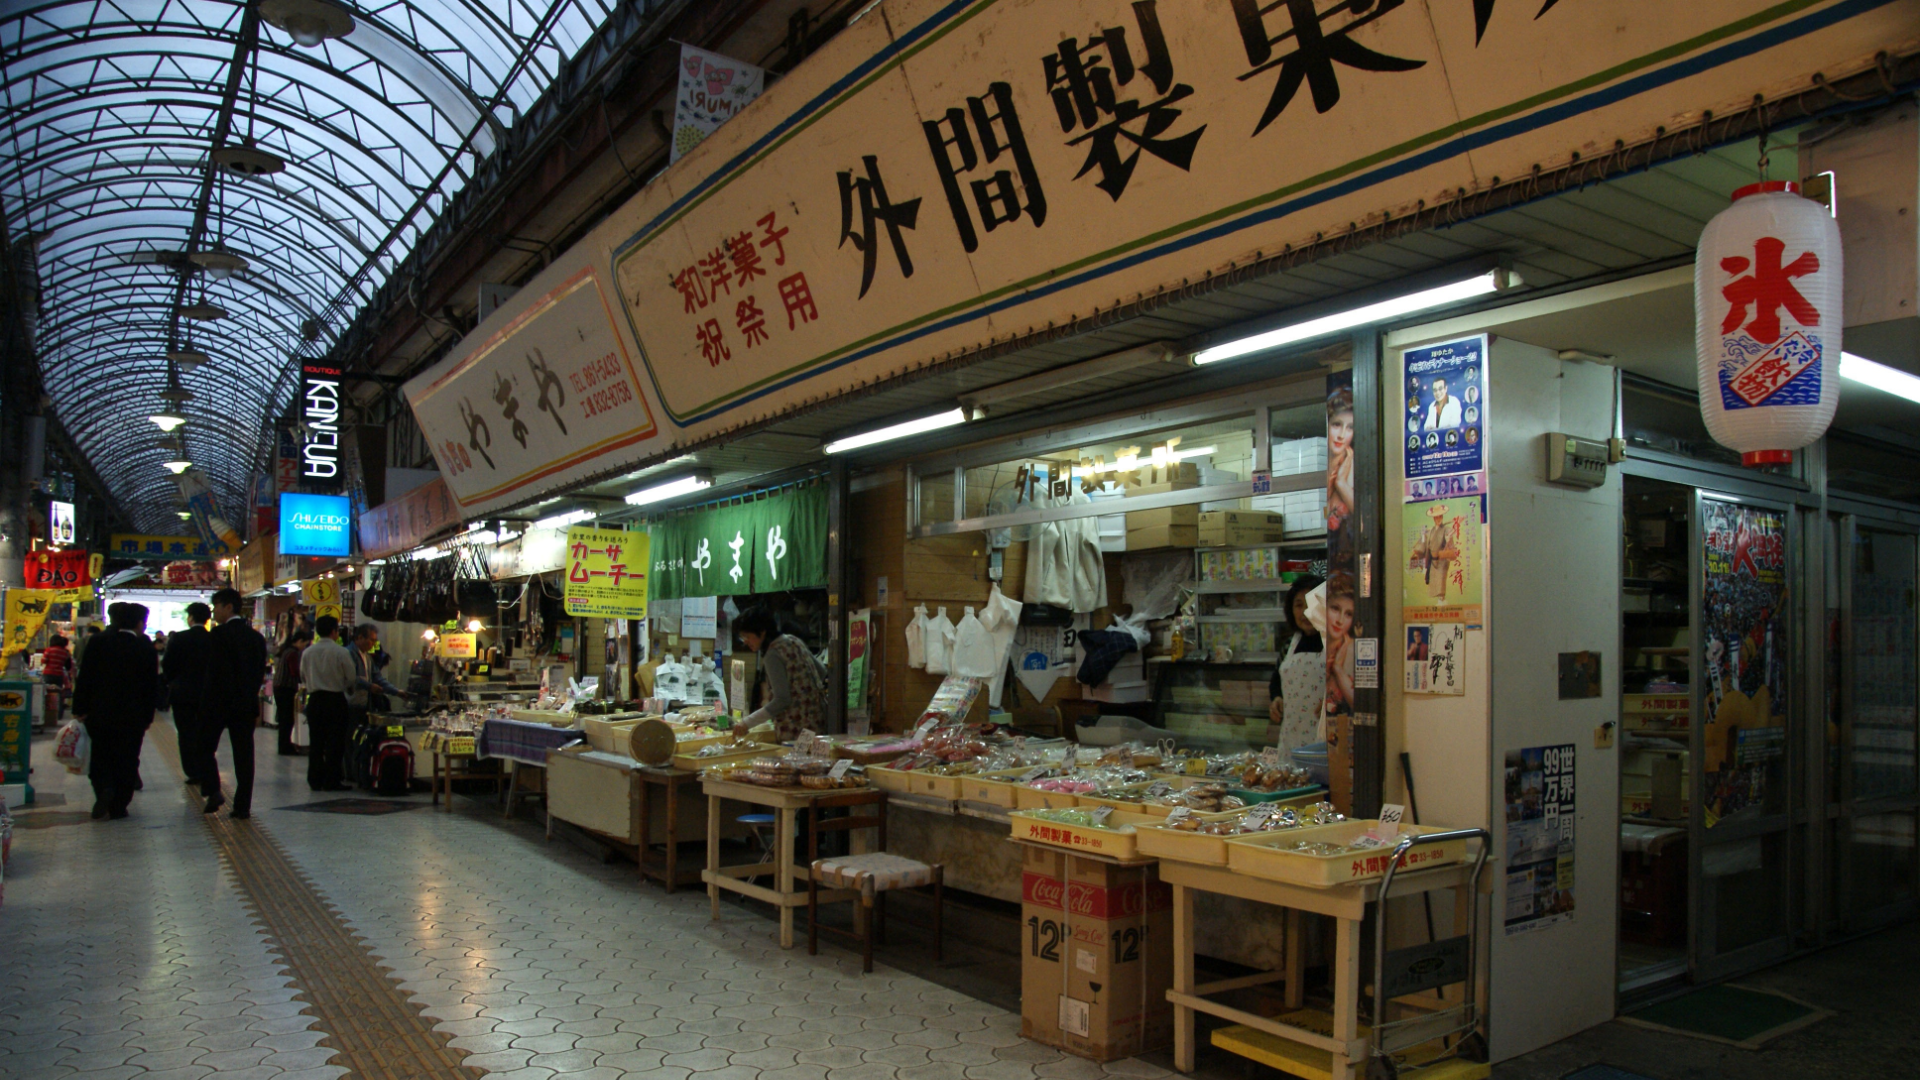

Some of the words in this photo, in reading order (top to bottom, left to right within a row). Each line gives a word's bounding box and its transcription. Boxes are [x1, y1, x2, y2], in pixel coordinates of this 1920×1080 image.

[675, 211, 789, 315] 和洋菓子
[1719, 236, 1821, 345] 氷
[696, 271, 819, 368] 祝祭用
[304, 365, 342, 376] BOUTIQUE
[569, 372, 587, 395] TEL
[583, 352, 622, 387] 861-5433
[457, 346, 567, 471] やまや
[592, 379, 632, 414] 832-8758
[287, 511, 350, 526] SHISEIDO
[294, 522, 343, 533] CHAINSTORE
[570, 540, 623, 563] カーサ
[691, 524, 788, 588] やまや
[569, 560, 645, 587] ムーチー
[1543, 748, 1561, 831] 99万円
[1559, 746, 1575, 842] 世界一周
[1029, 824, 1072, 846] 外間製菓
